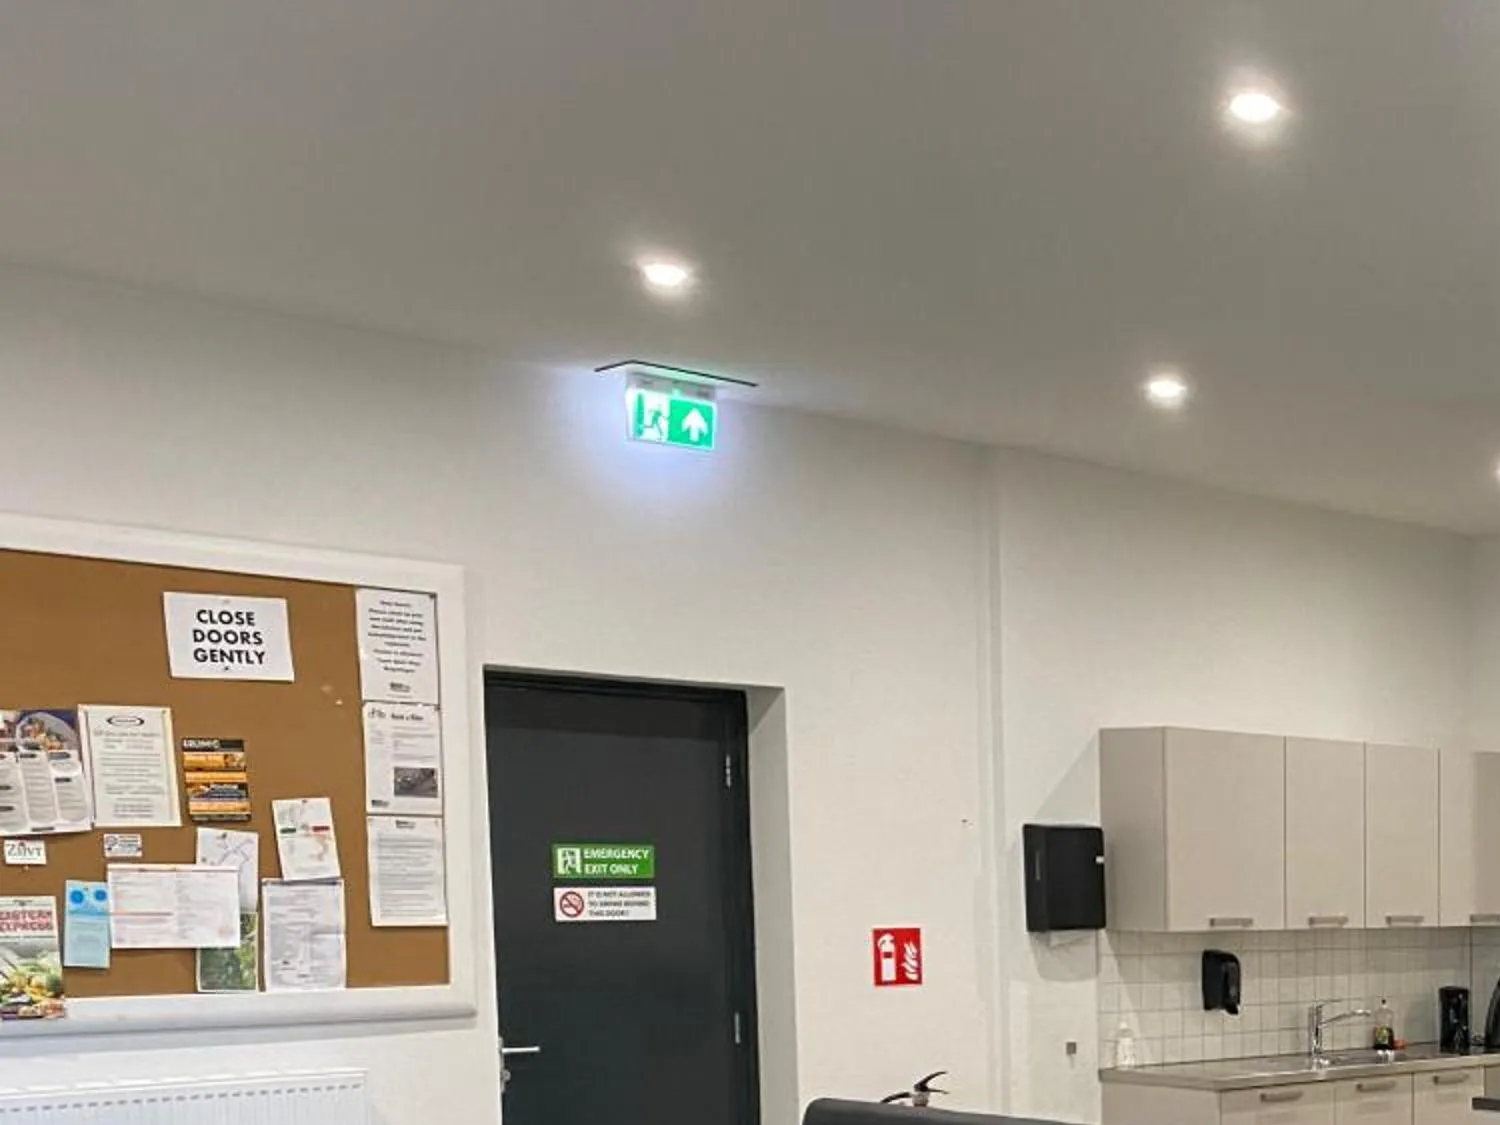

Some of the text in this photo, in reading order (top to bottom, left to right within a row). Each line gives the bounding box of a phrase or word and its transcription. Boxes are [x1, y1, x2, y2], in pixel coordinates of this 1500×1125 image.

[196, 609, 255, 626] CLOSE
[192, 629, 263, 645] DOORS
[193, 647, 265, 665] GENTLY
[583, 847, 649, 860] EMERGENCY
[584, 863, 639, 875] EXIT ONLY
